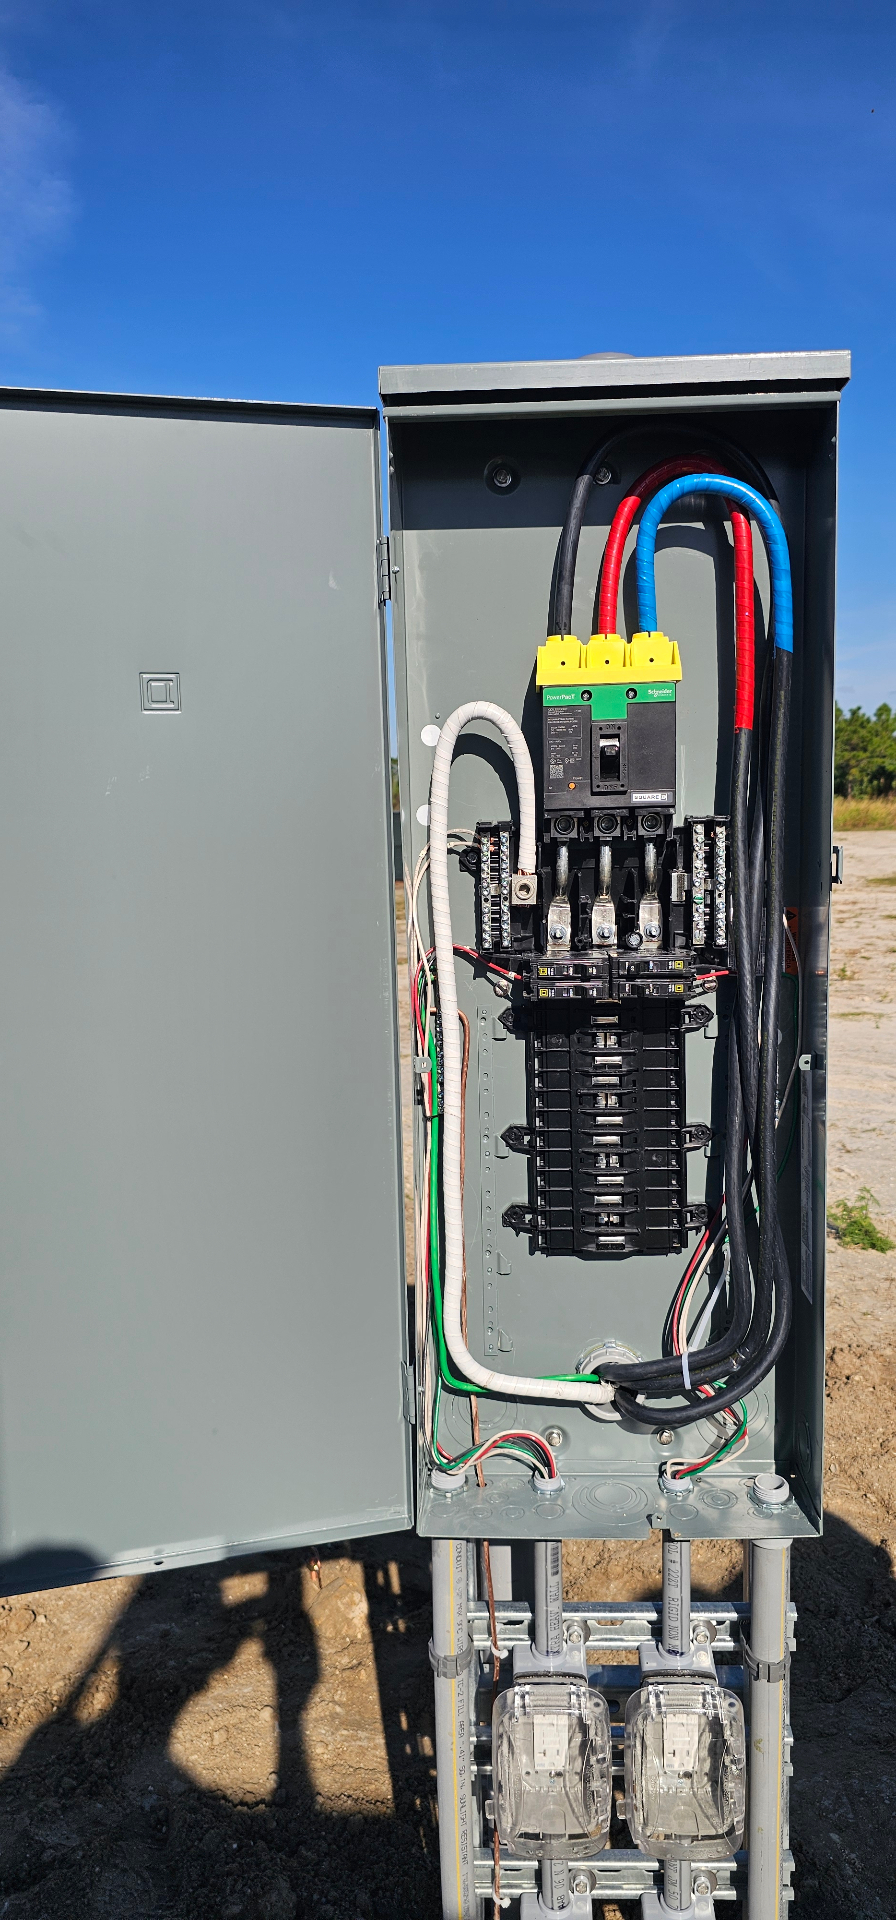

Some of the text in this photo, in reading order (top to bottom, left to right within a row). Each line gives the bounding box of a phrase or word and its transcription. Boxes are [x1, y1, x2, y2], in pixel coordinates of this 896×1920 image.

[455, 1542, 463, 1573] CONDUIT
[549, 1606, 560, 1632] HEAV
[667, 1596, 680, 1622] RIGID
[459, 1793, 467, 1827] SUNLIGHT
[460, 1829, 469, 1866] RESISTANT
